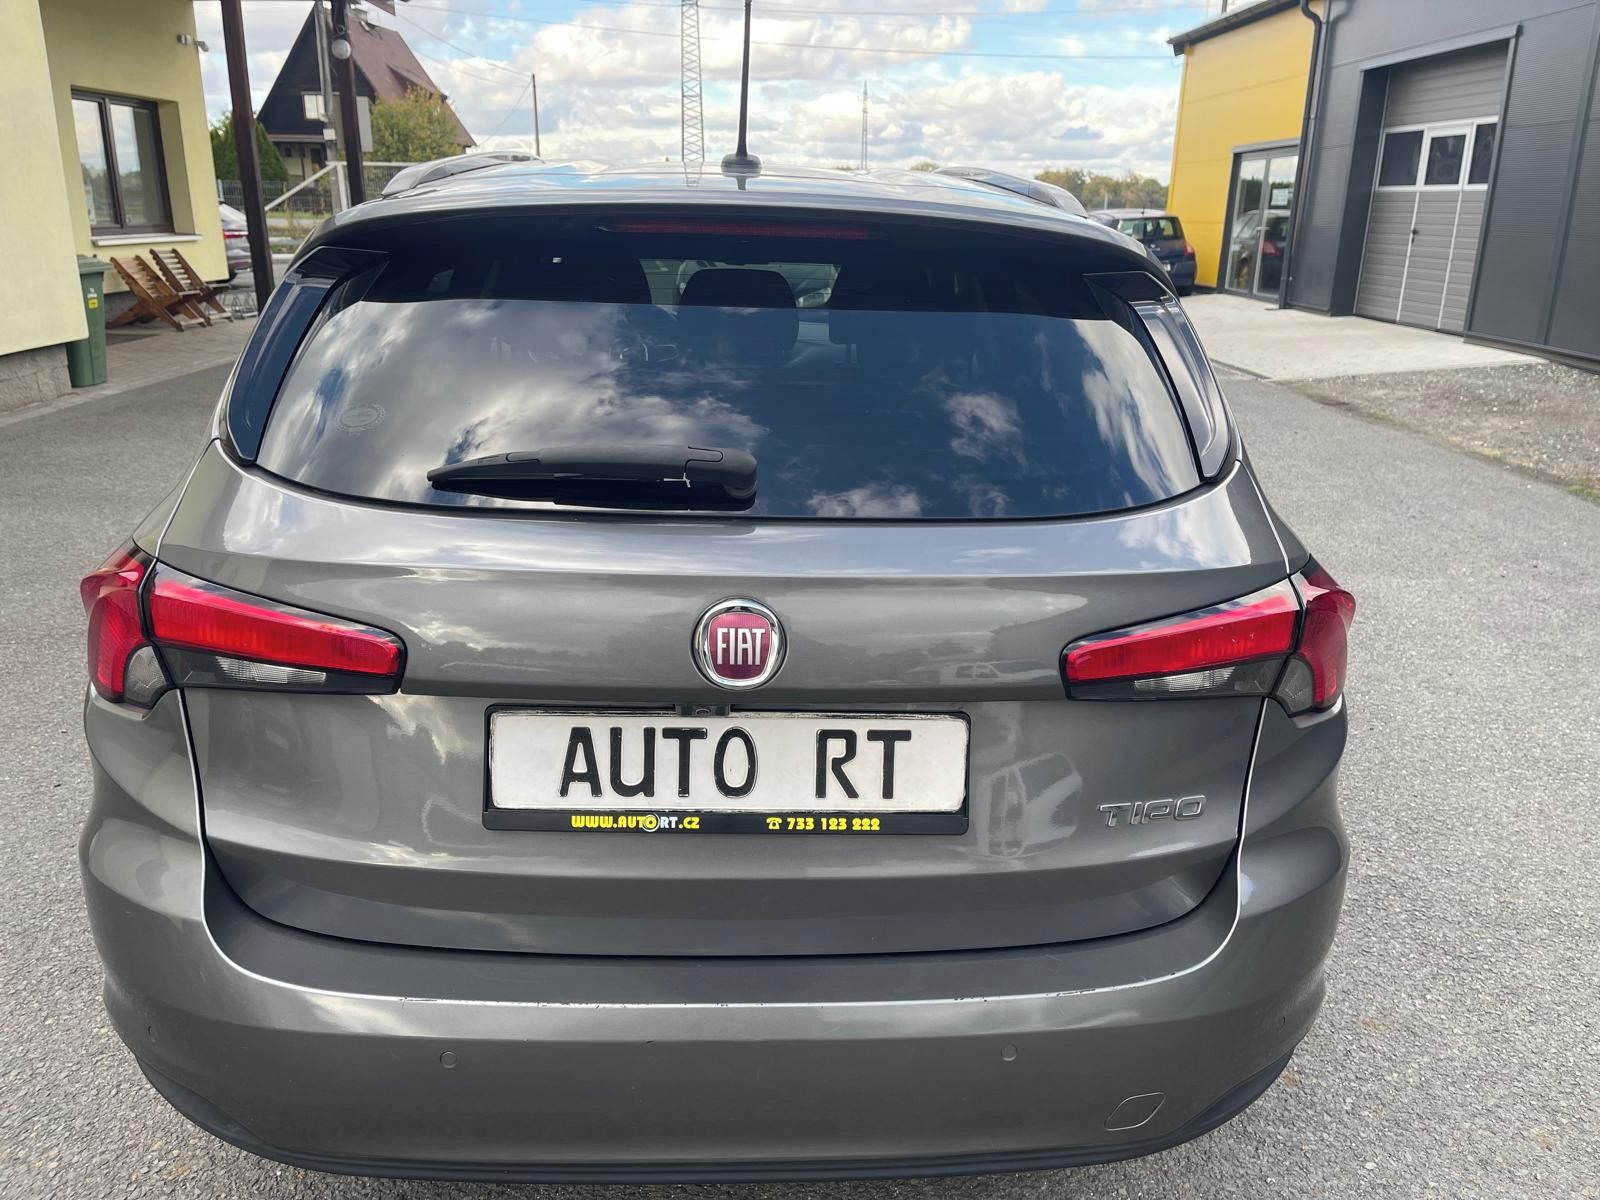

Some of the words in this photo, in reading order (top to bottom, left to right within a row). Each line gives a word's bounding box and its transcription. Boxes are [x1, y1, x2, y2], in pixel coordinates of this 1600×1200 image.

[717, 627, 766, 666] FIAT
[559, 727, 758, 798] AUTO
[815, 729, 912, 799] RT
[786, 817, 815, 830] 733
[820, 817, 847, 831] 123
[851, 817, 880, 831] 222
[1099, 795, 1206, 827] TIPO
